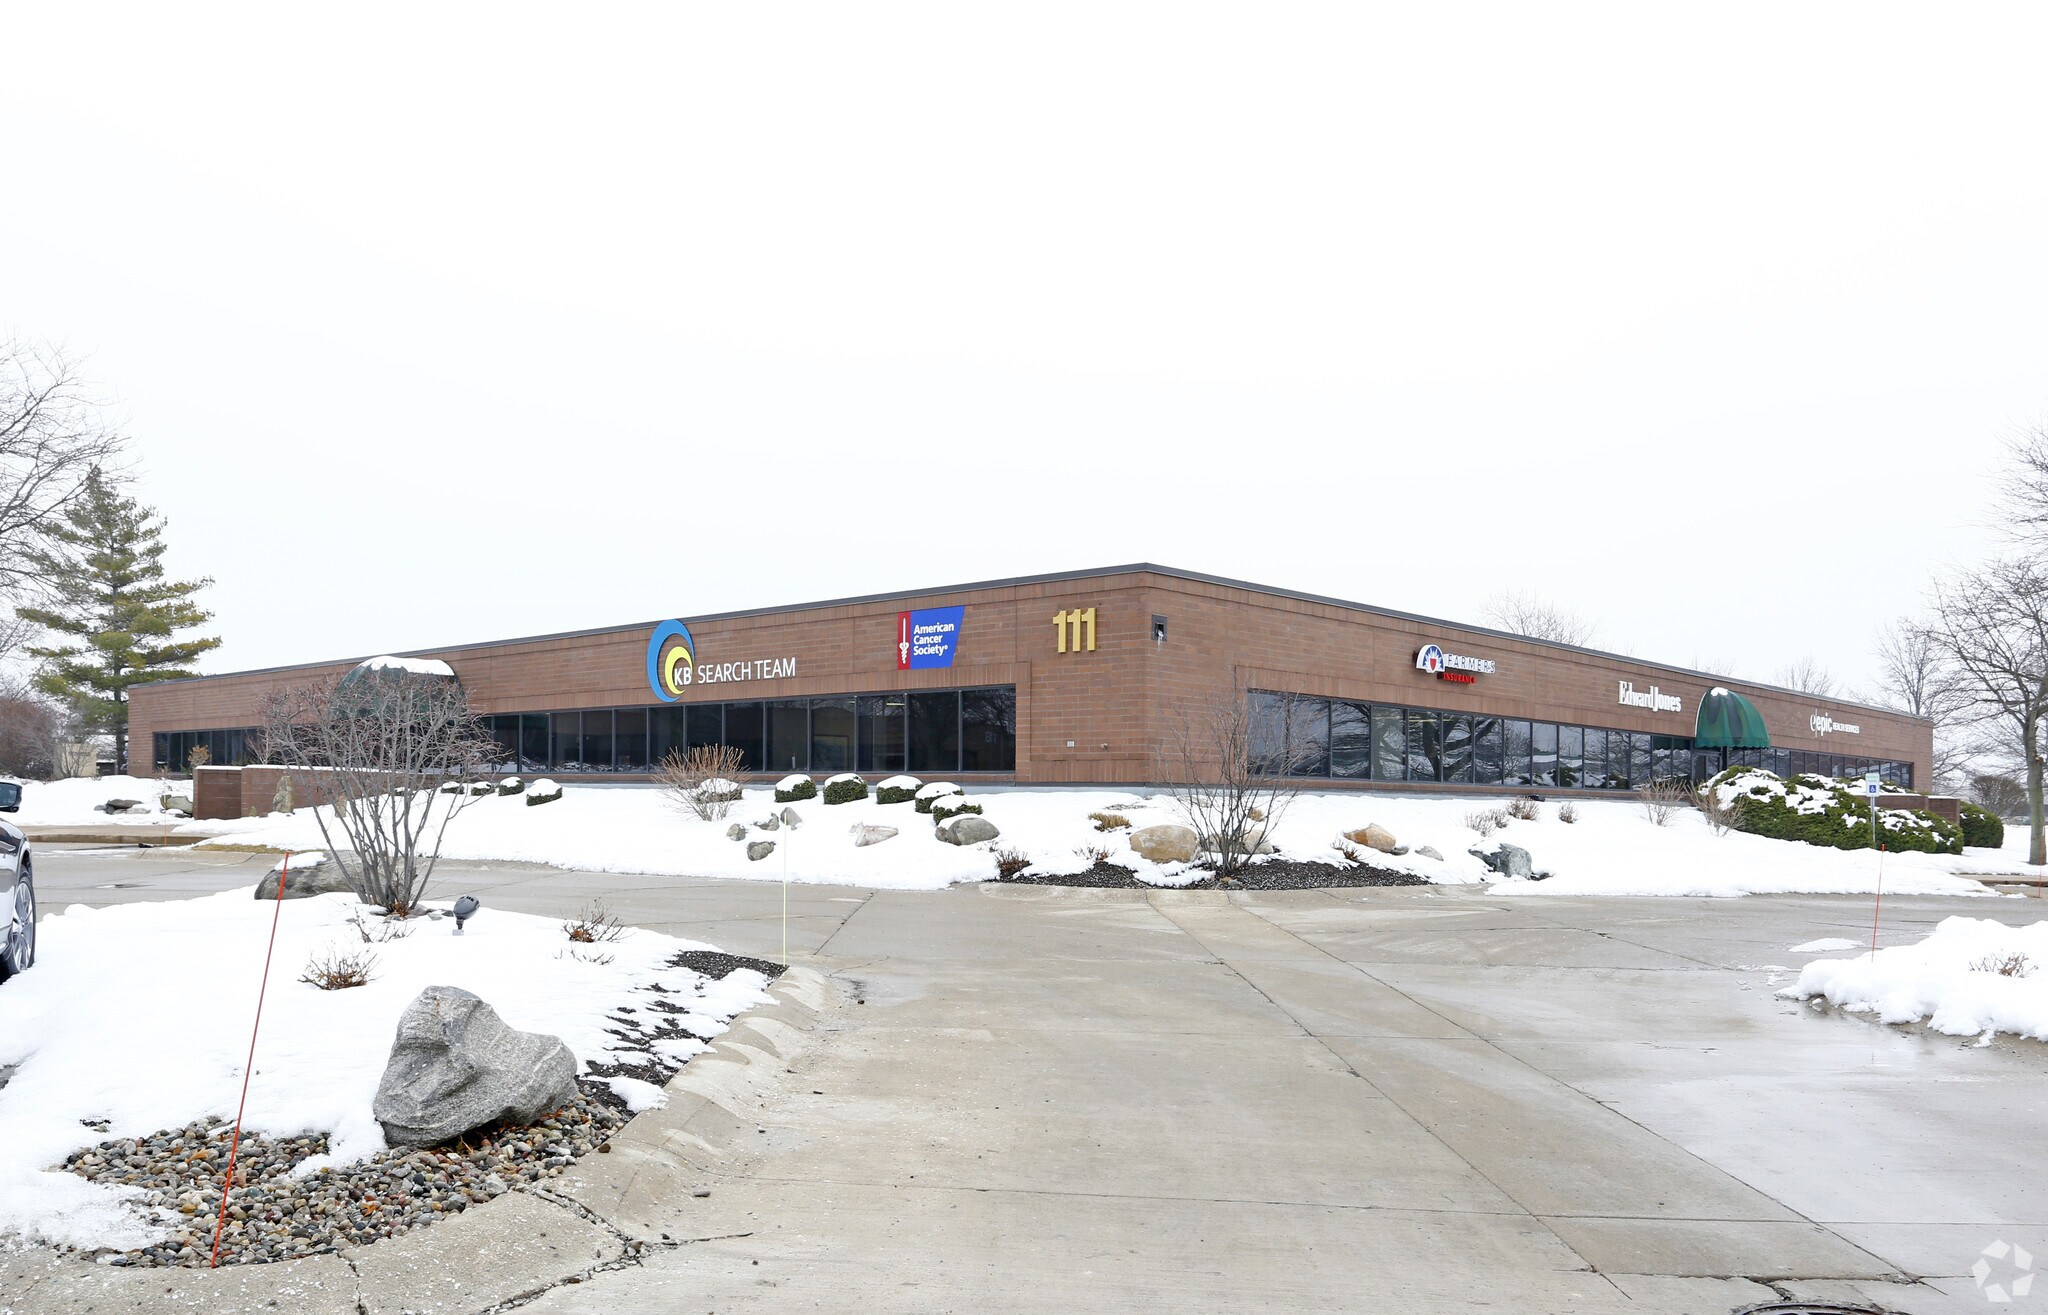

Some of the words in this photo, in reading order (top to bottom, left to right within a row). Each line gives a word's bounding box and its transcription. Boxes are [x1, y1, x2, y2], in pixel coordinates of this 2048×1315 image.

[913, 622, 955, 635] American
[1053, 608, 1097, 653] 111
[913, 635, 943, 645] Cancer
[674, 666, 692, 686] KB
[698, 661, 751, 684] SEARCH
[754, 657, 796, 680] TEAM
[1446, 654, 1495, 673] FARMERS
